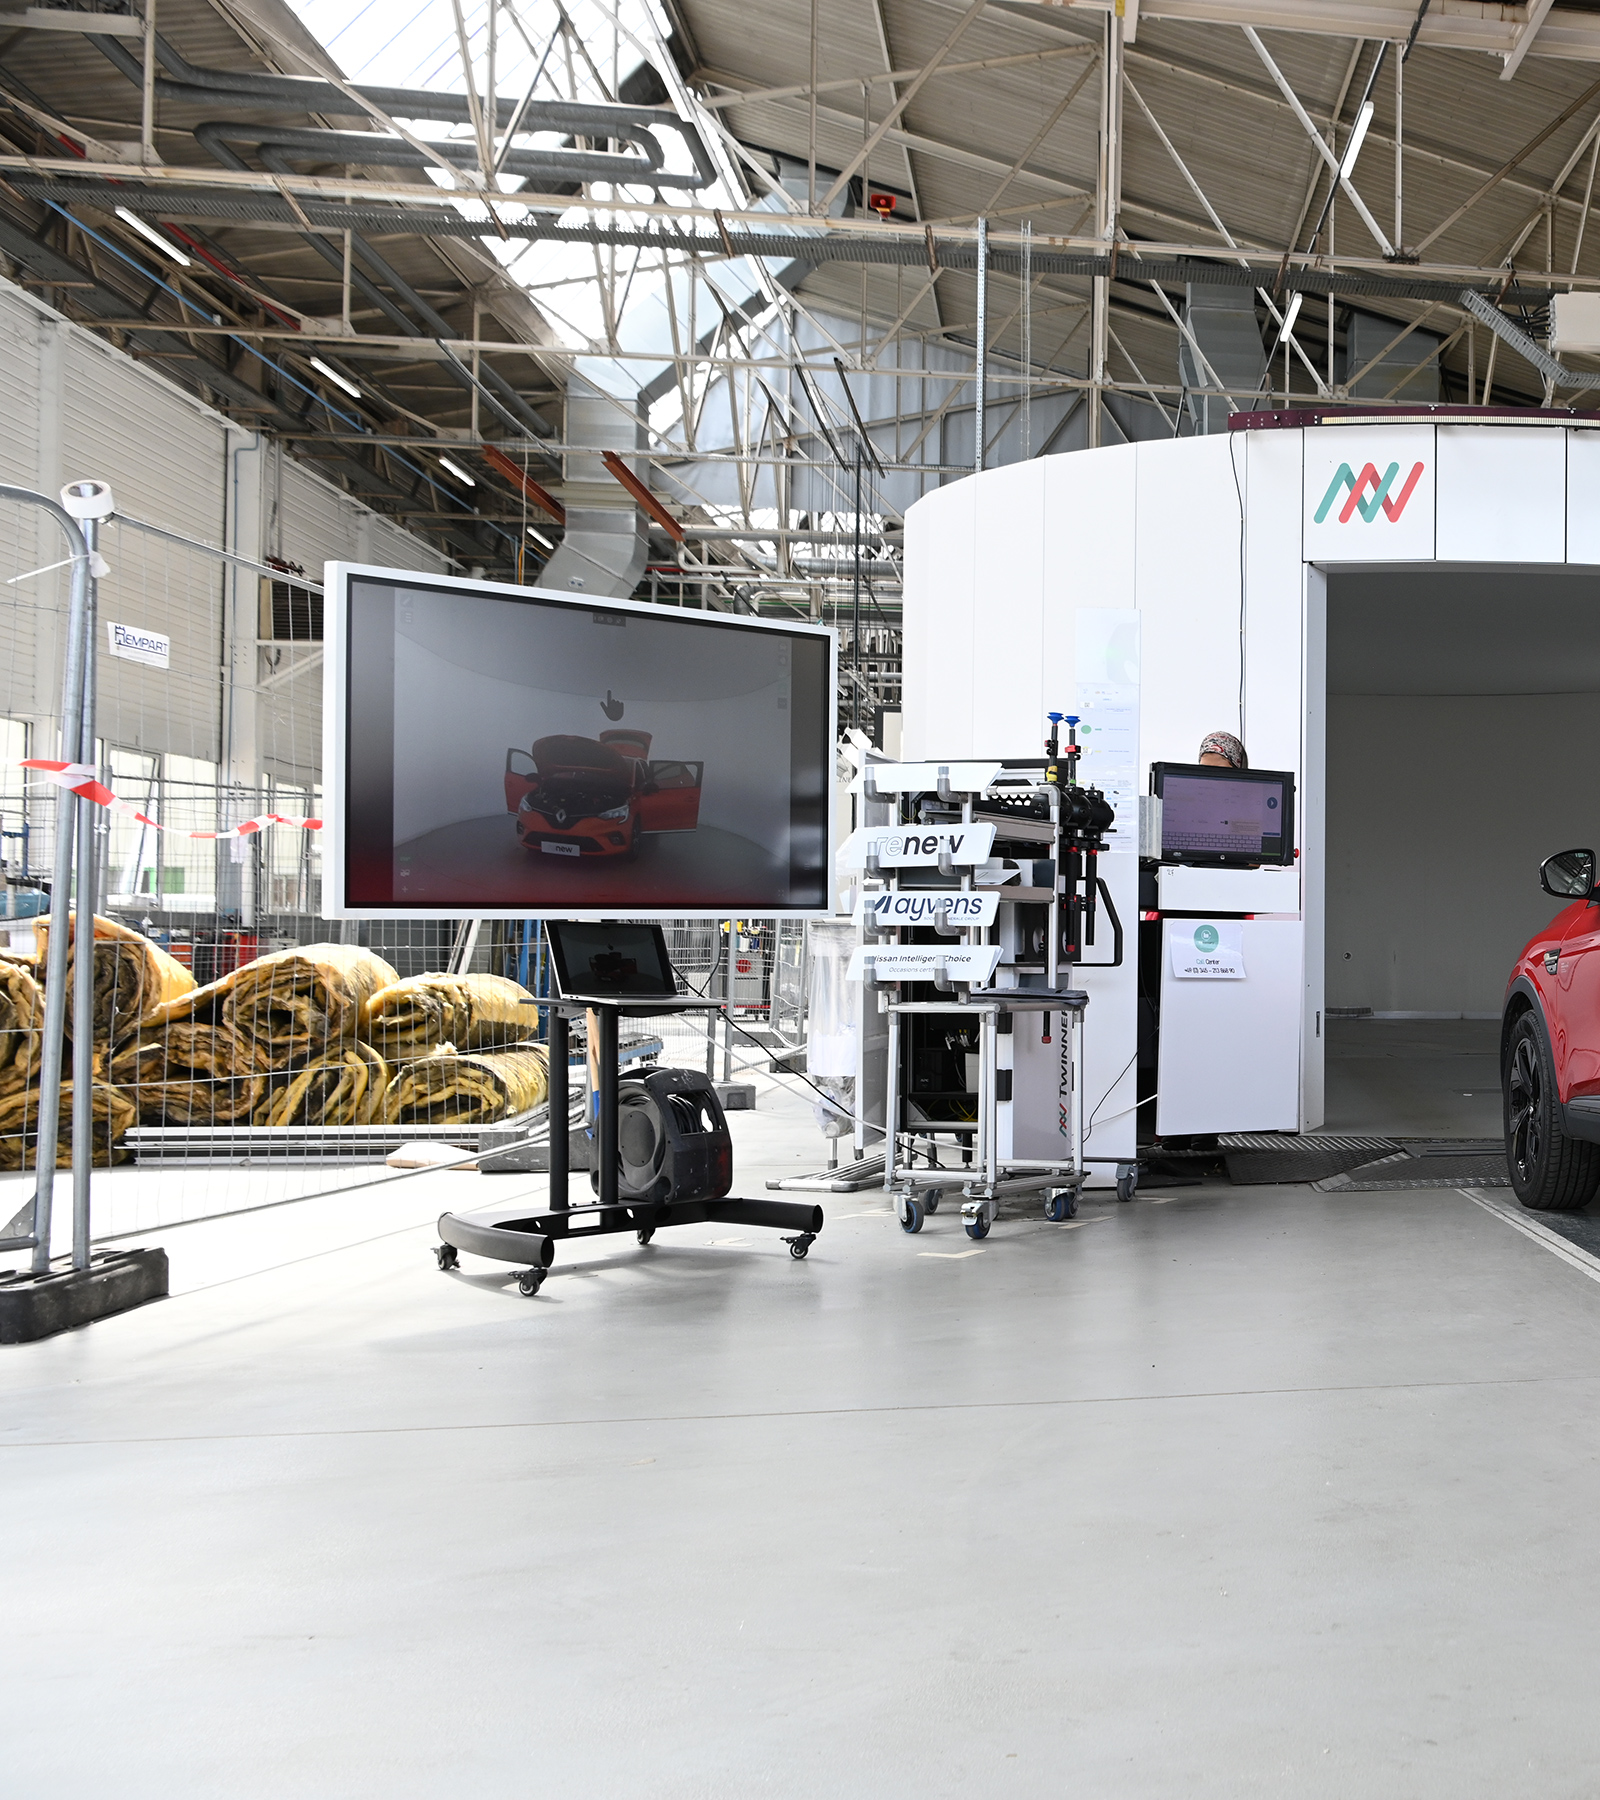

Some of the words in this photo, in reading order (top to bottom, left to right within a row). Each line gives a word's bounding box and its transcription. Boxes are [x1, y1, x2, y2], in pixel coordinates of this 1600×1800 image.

[114, 625, 168, 653] REMPART
[894, 896, 983, 922] ayvens
[899, 955, 936, 964] Intellige
